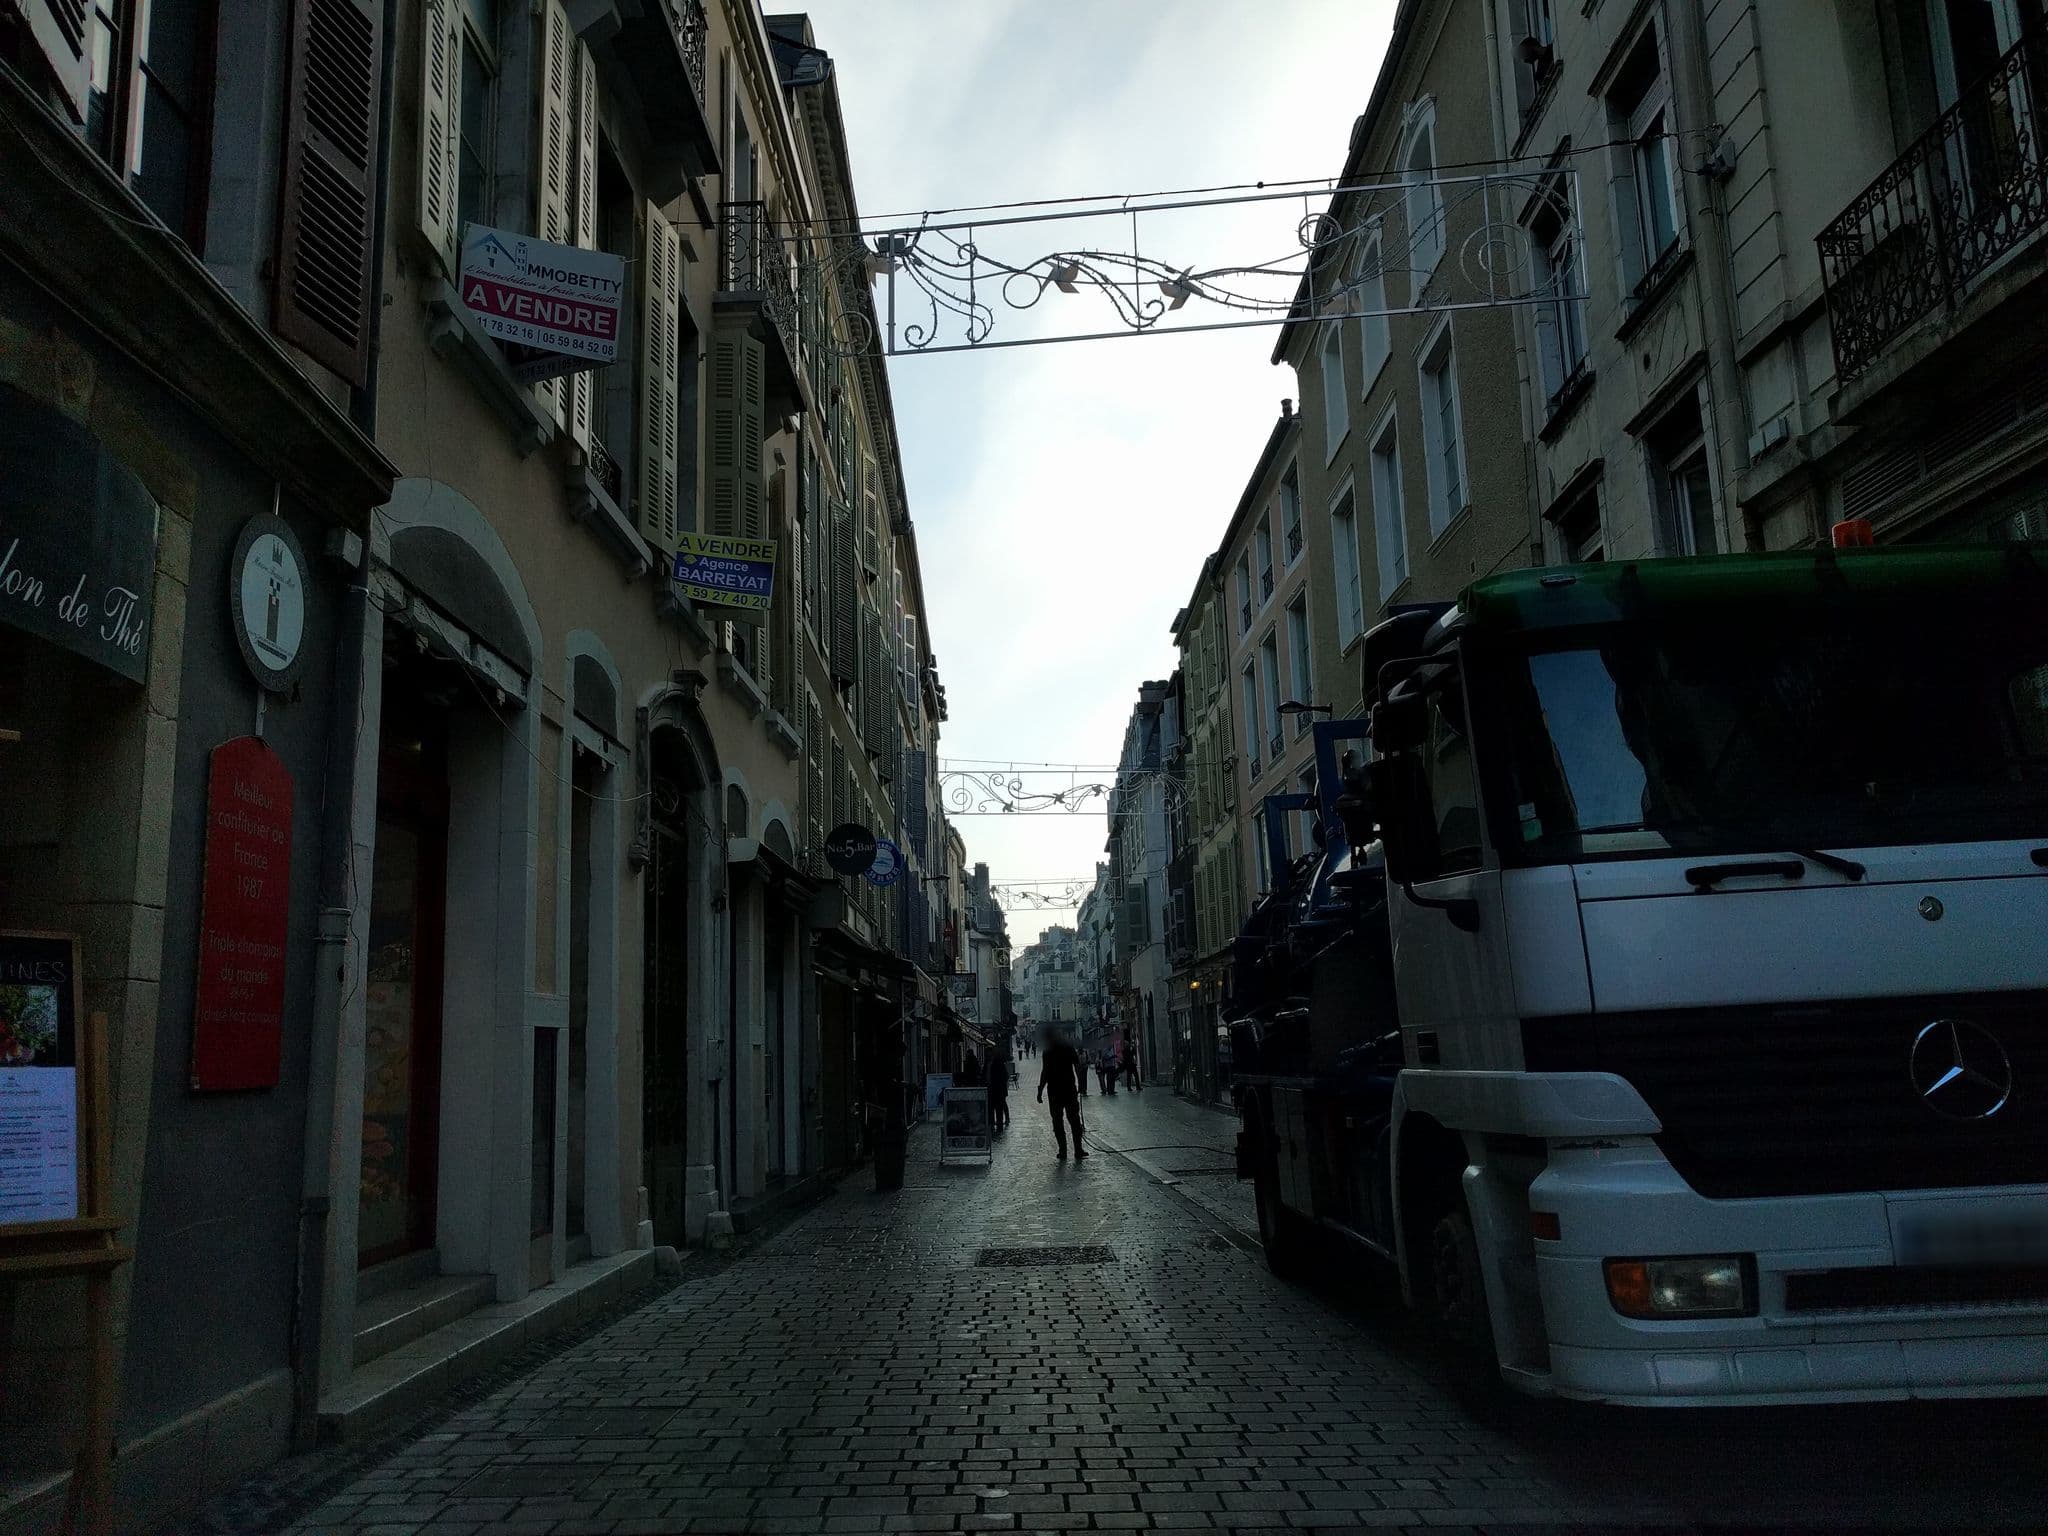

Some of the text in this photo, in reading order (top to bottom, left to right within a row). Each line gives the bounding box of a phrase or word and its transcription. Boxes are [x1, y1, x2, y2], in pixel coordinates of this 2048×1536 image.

[467, 284, 611, 334] A VENDRE
[491, 319, 504, 332] 78
[506, 323, 518, 336] 32
[521, 326, 534, 340] 16
[542, 332, 555, 344] 05
[557, 335, 570, 347] 59
[572, 338, 584, 351] 84
[587, 341, 599, 354] 52
[602, 344, 614, 356] 08
[678, 536, 773, 559] A VENDRE
[698, 556, 749, 572] Agence
[678, 566, 767, 589] BARREYAT
[692, 587, 708, 599] 59
[712, 590, 728, 602] 27
[732, 595, 748, 606] 40
[752, 596, 768, 608] 20
[58, 573, 89, 628] de
[100, 586, 144, 656] Thé
[234, 841, 269, 870] France
[238, 874, 264, 900] 1987
